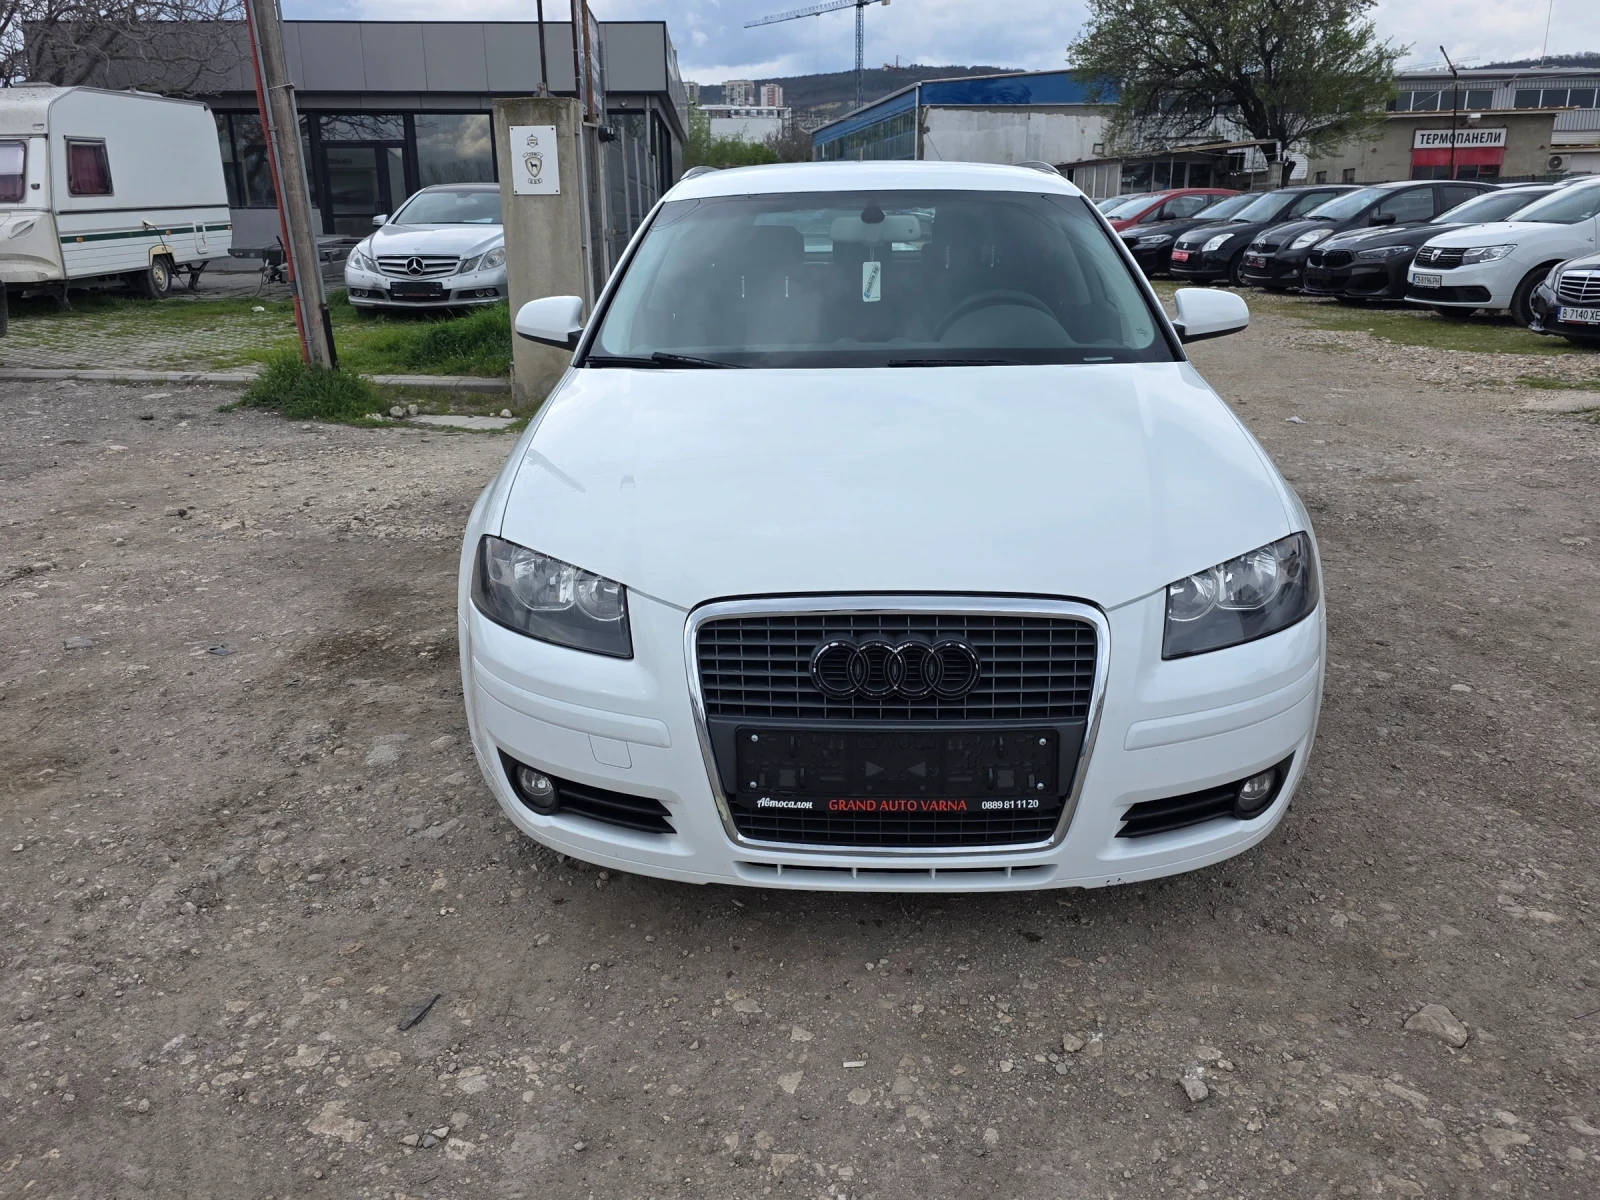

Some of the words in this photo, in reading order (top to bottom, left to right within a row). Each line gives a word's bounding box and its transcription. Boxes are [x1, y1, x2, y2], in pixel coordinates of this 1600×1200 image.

[1420, 132, 1501, 144] ТЕРМОПАНЕЛИ
[1570, 309, 1588, 320] 7140
[757, 797, 813, 809] Автосалон
[828, 800, 876, 811] GRAND
[880, 800, 917, 811] AUTO
[921, 800, 967, 811] VARNA
